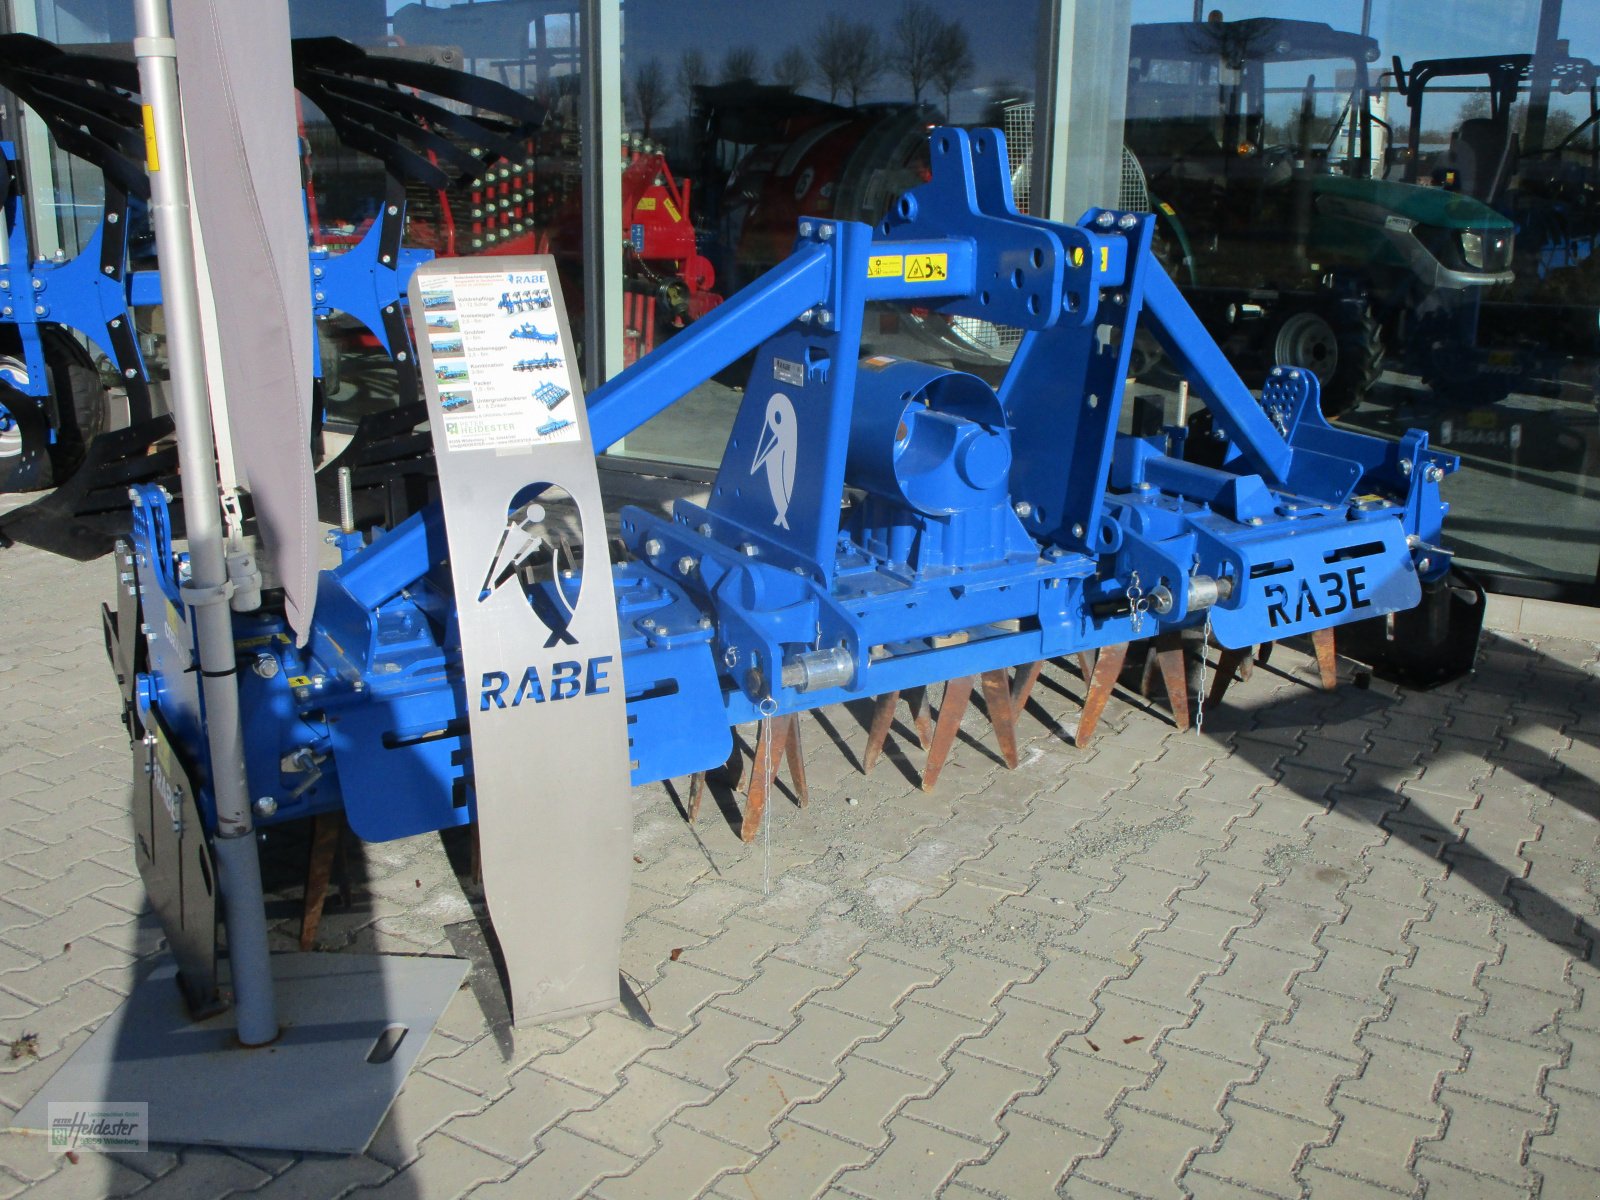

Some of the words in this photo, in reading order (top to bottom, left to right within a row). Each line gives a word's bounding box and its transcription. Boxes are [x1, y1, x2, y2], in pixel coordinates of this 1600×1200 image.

[515, 274, 546, 284] RABE
[461, 424, 515, 434] HEIDESTER
[1264, 565, 1372, 628] RABE
[480, 655, 613, 711] RABE
